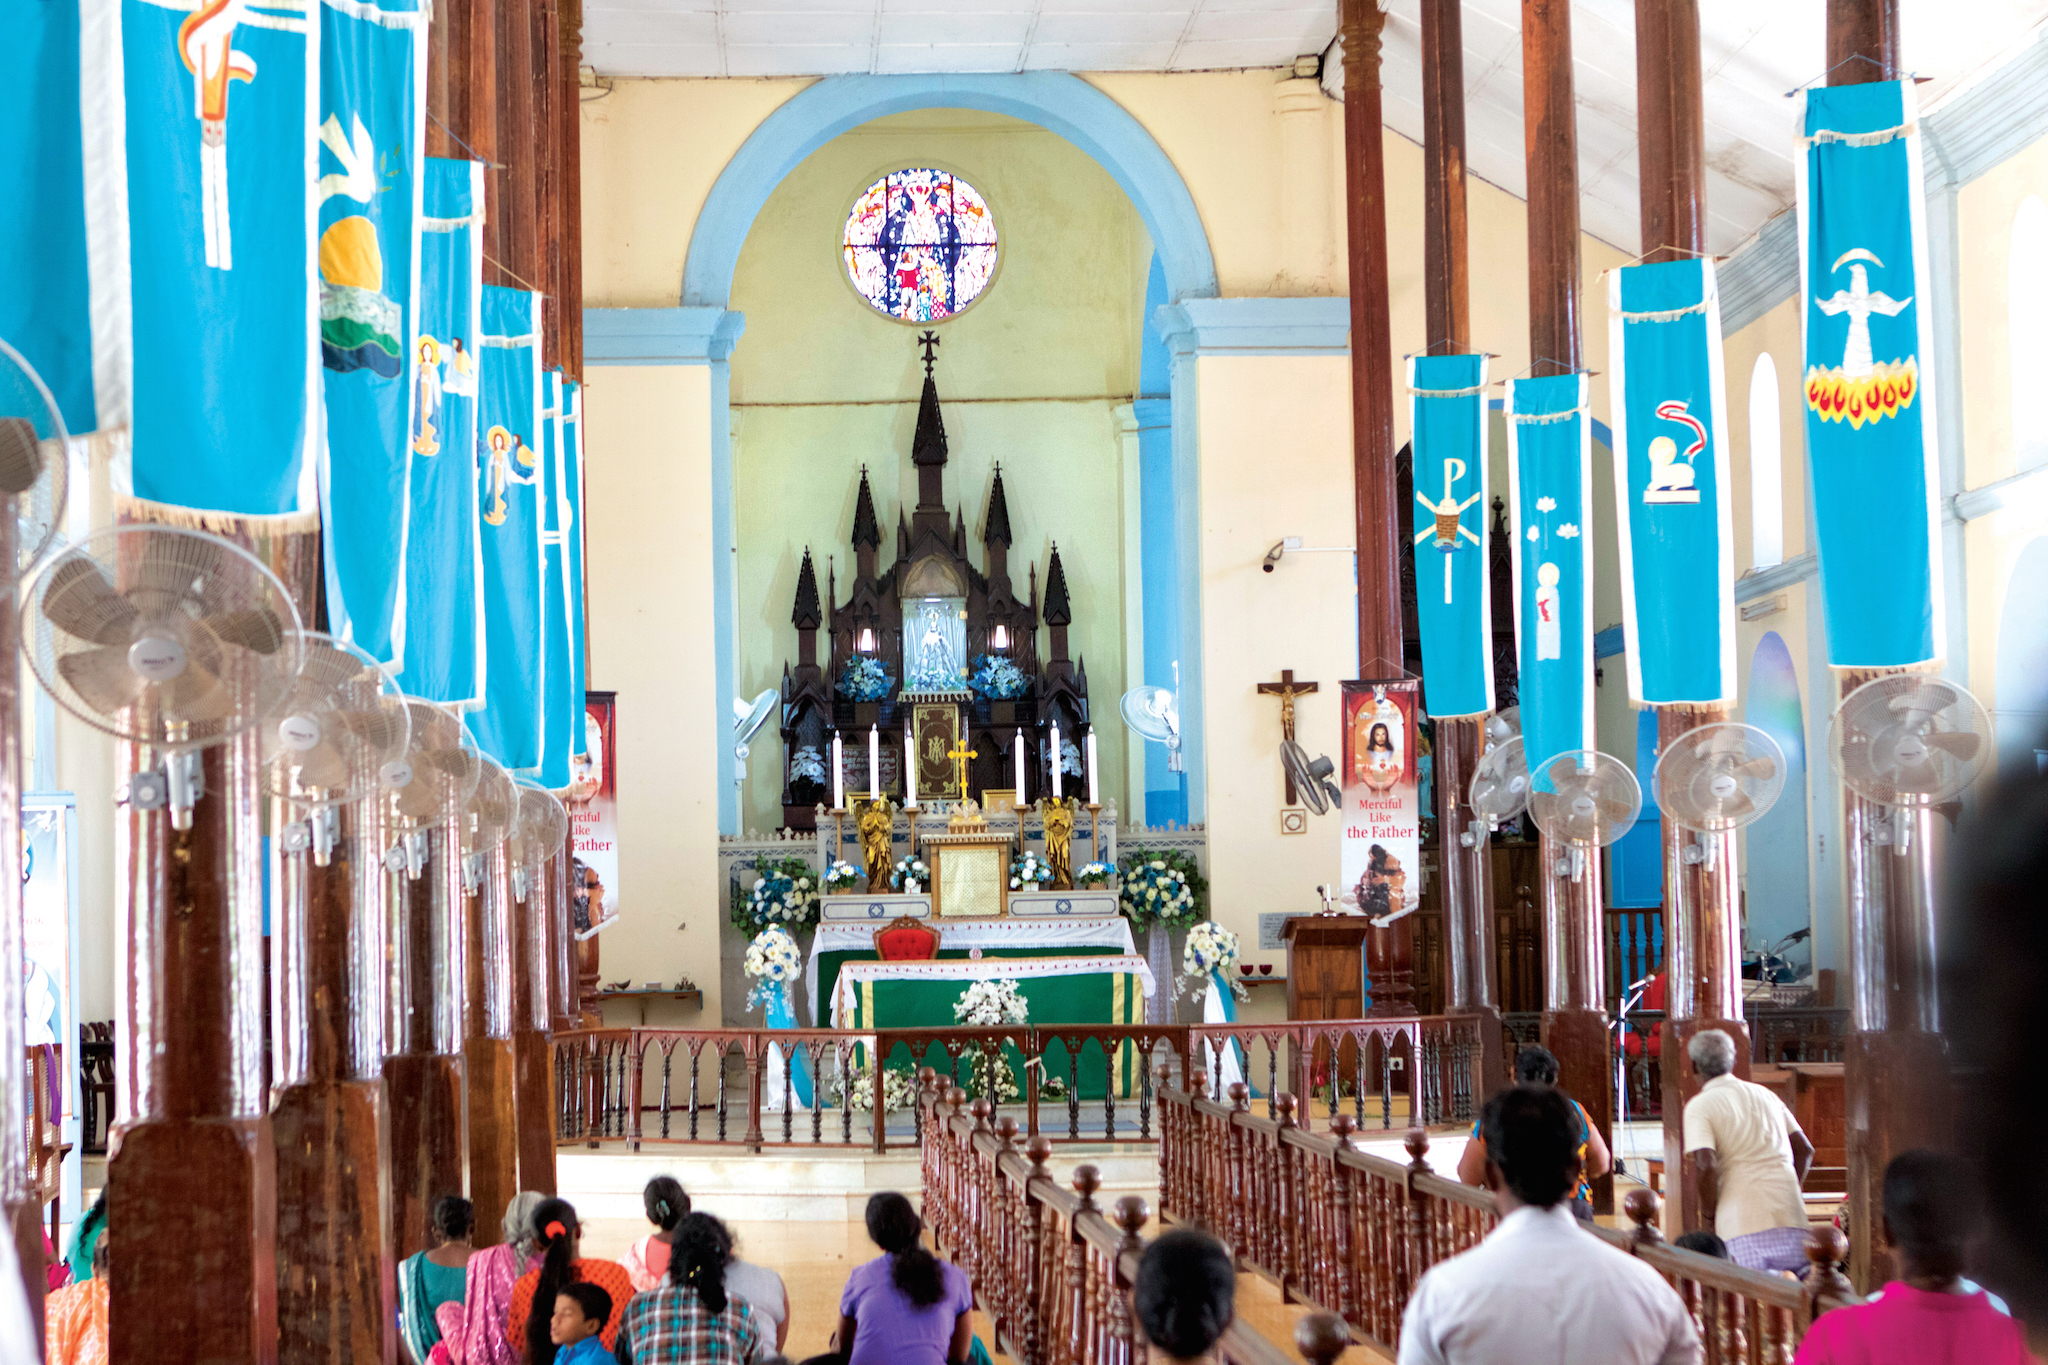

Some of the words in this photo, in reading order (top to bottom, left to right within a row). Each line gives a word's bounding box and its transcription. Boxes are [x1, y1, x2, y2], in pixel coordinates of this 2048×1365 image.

[1359, 799, 1402, 810] Merciful
[573, 811, 600, 822] rciful
[1370, 812, 1392, 823] Like
[1347, 826, 1368, 838] the
[1372, 825, 1414, 838] Father
[572, 838, 612, 851] Father
